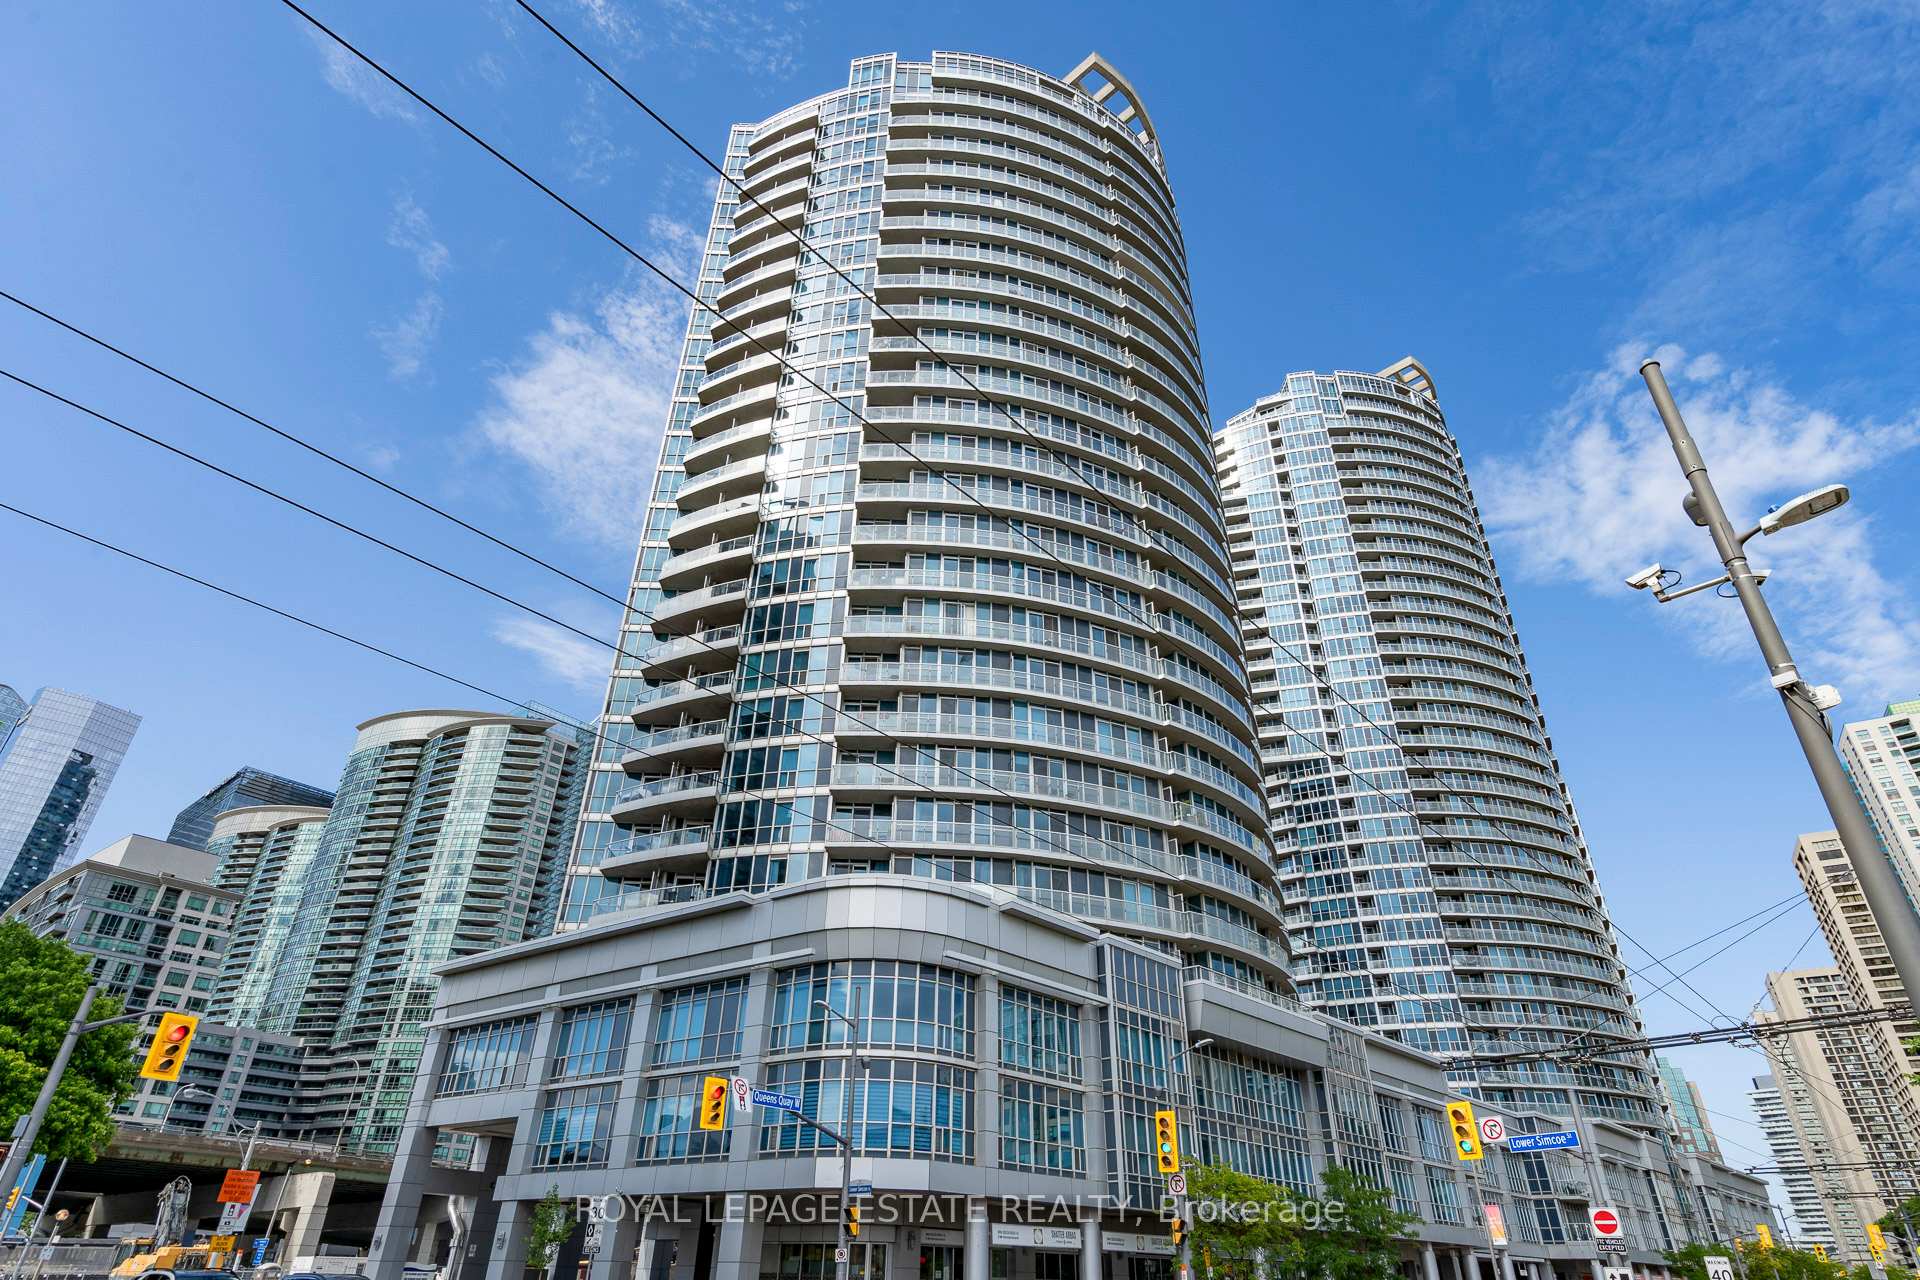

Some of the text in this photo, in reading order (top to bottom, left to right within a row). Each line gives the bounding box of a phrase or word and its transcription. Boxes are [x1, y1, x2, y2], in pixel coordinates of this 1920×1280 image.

[754, 1091, 801, 1109] Queens Quay W
[1511, 1137, 1535, 1149] Lower
[1535, 1135, 1567, 1146] Simcoe
[1711, 1269, 1732, 1280] 40
